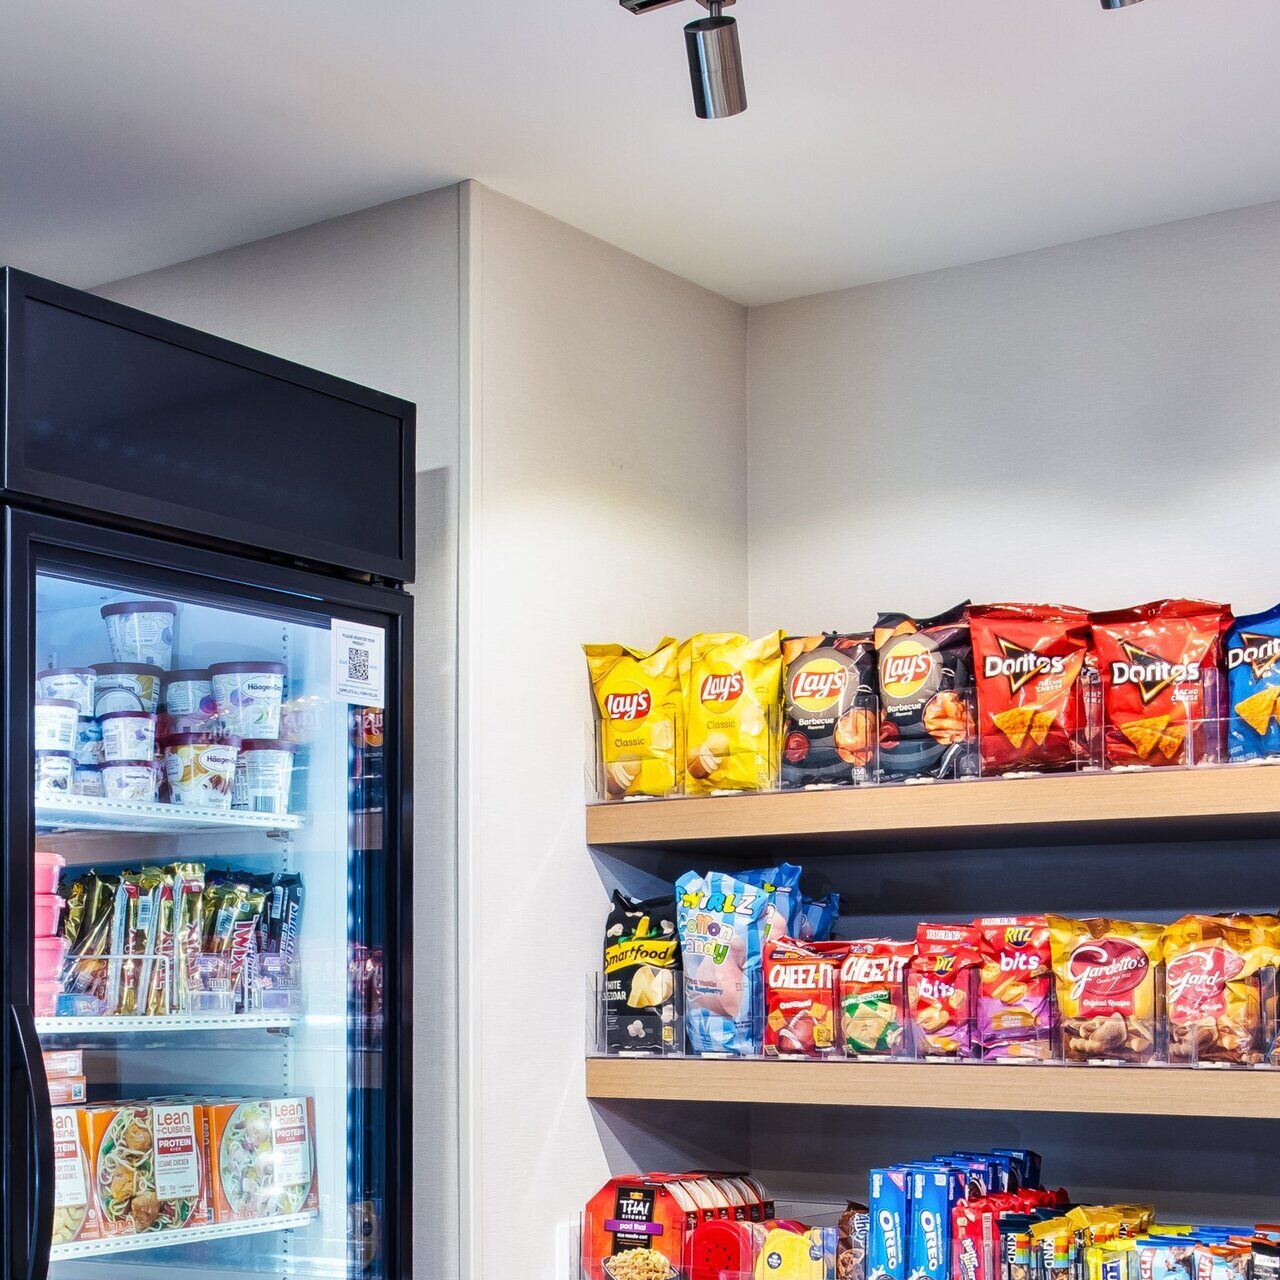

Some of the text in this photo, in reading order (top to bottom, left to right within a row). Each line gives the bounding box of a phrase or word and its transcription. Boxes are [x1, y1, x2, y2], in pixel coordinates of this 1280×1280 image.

[882, 652, 929, 685] Lay's
[983, 653, 1066, 680] Doritos
[1111, 659, 1201, 685] Doritos
[701, 671, 745, 702] Lay's
[793, 665, 846, 698] Lay's
[1173, 687, 1200, 697] NACHO
[605, 690, 651, 721] Lay's
[886, 702, 922, 714] Barbecue
[706, 718, 736, 730] Classic
[798, 716, 835, 727] Barbecue
[614, 736, 645, 748] Classic
[1004, 926, 1034, 946] RITZ
[604, 943, 670, 971] Smartfood
[840, 954, 909, 983] CHEEZ-IT
[1000, 951, 1040, 973] bits
[1068, 937, 1147, 997] Gardetto's
[770, 963, 833, 989] CHEEZ-IT
[1111, 999, 1131, 1008] Recipe
[157, 1111, 190, 1127] Lean
[274, 1102, 304, 1118] Lean
[158, 1138, 192, 1149] PROTEIN
[276, 1129, 305, 1139] PROTEIN
[619, 1199, 651, 1216] THAI
[879, 1209, 897, 1270] OREO
[920, 1209, 938, 1271] OREO
[1007, 1232, 1017, 1264] KIND
[1043, 1238, 1055, 1269] KIND
